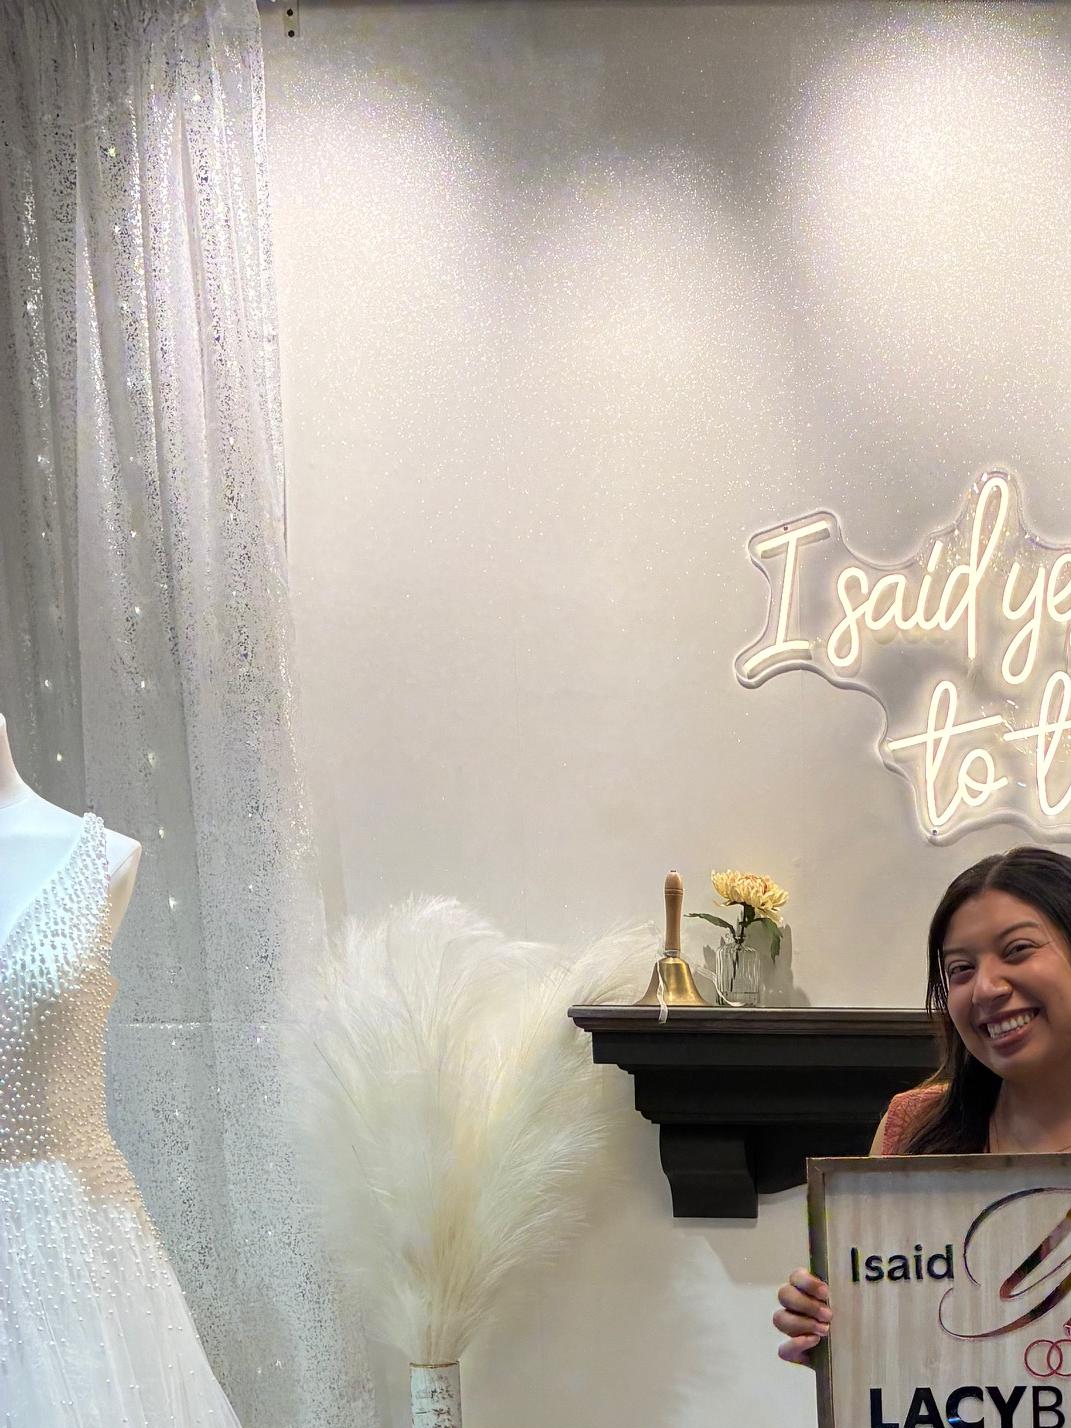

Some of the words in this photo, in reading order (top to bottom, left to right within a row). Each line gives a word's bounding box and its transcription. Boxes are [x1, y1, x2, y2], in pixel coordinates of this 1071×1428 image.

[743, 519, 831, 680] I
[826, 477, 1010, 668] said
[888, 680, 1009, 827] to
